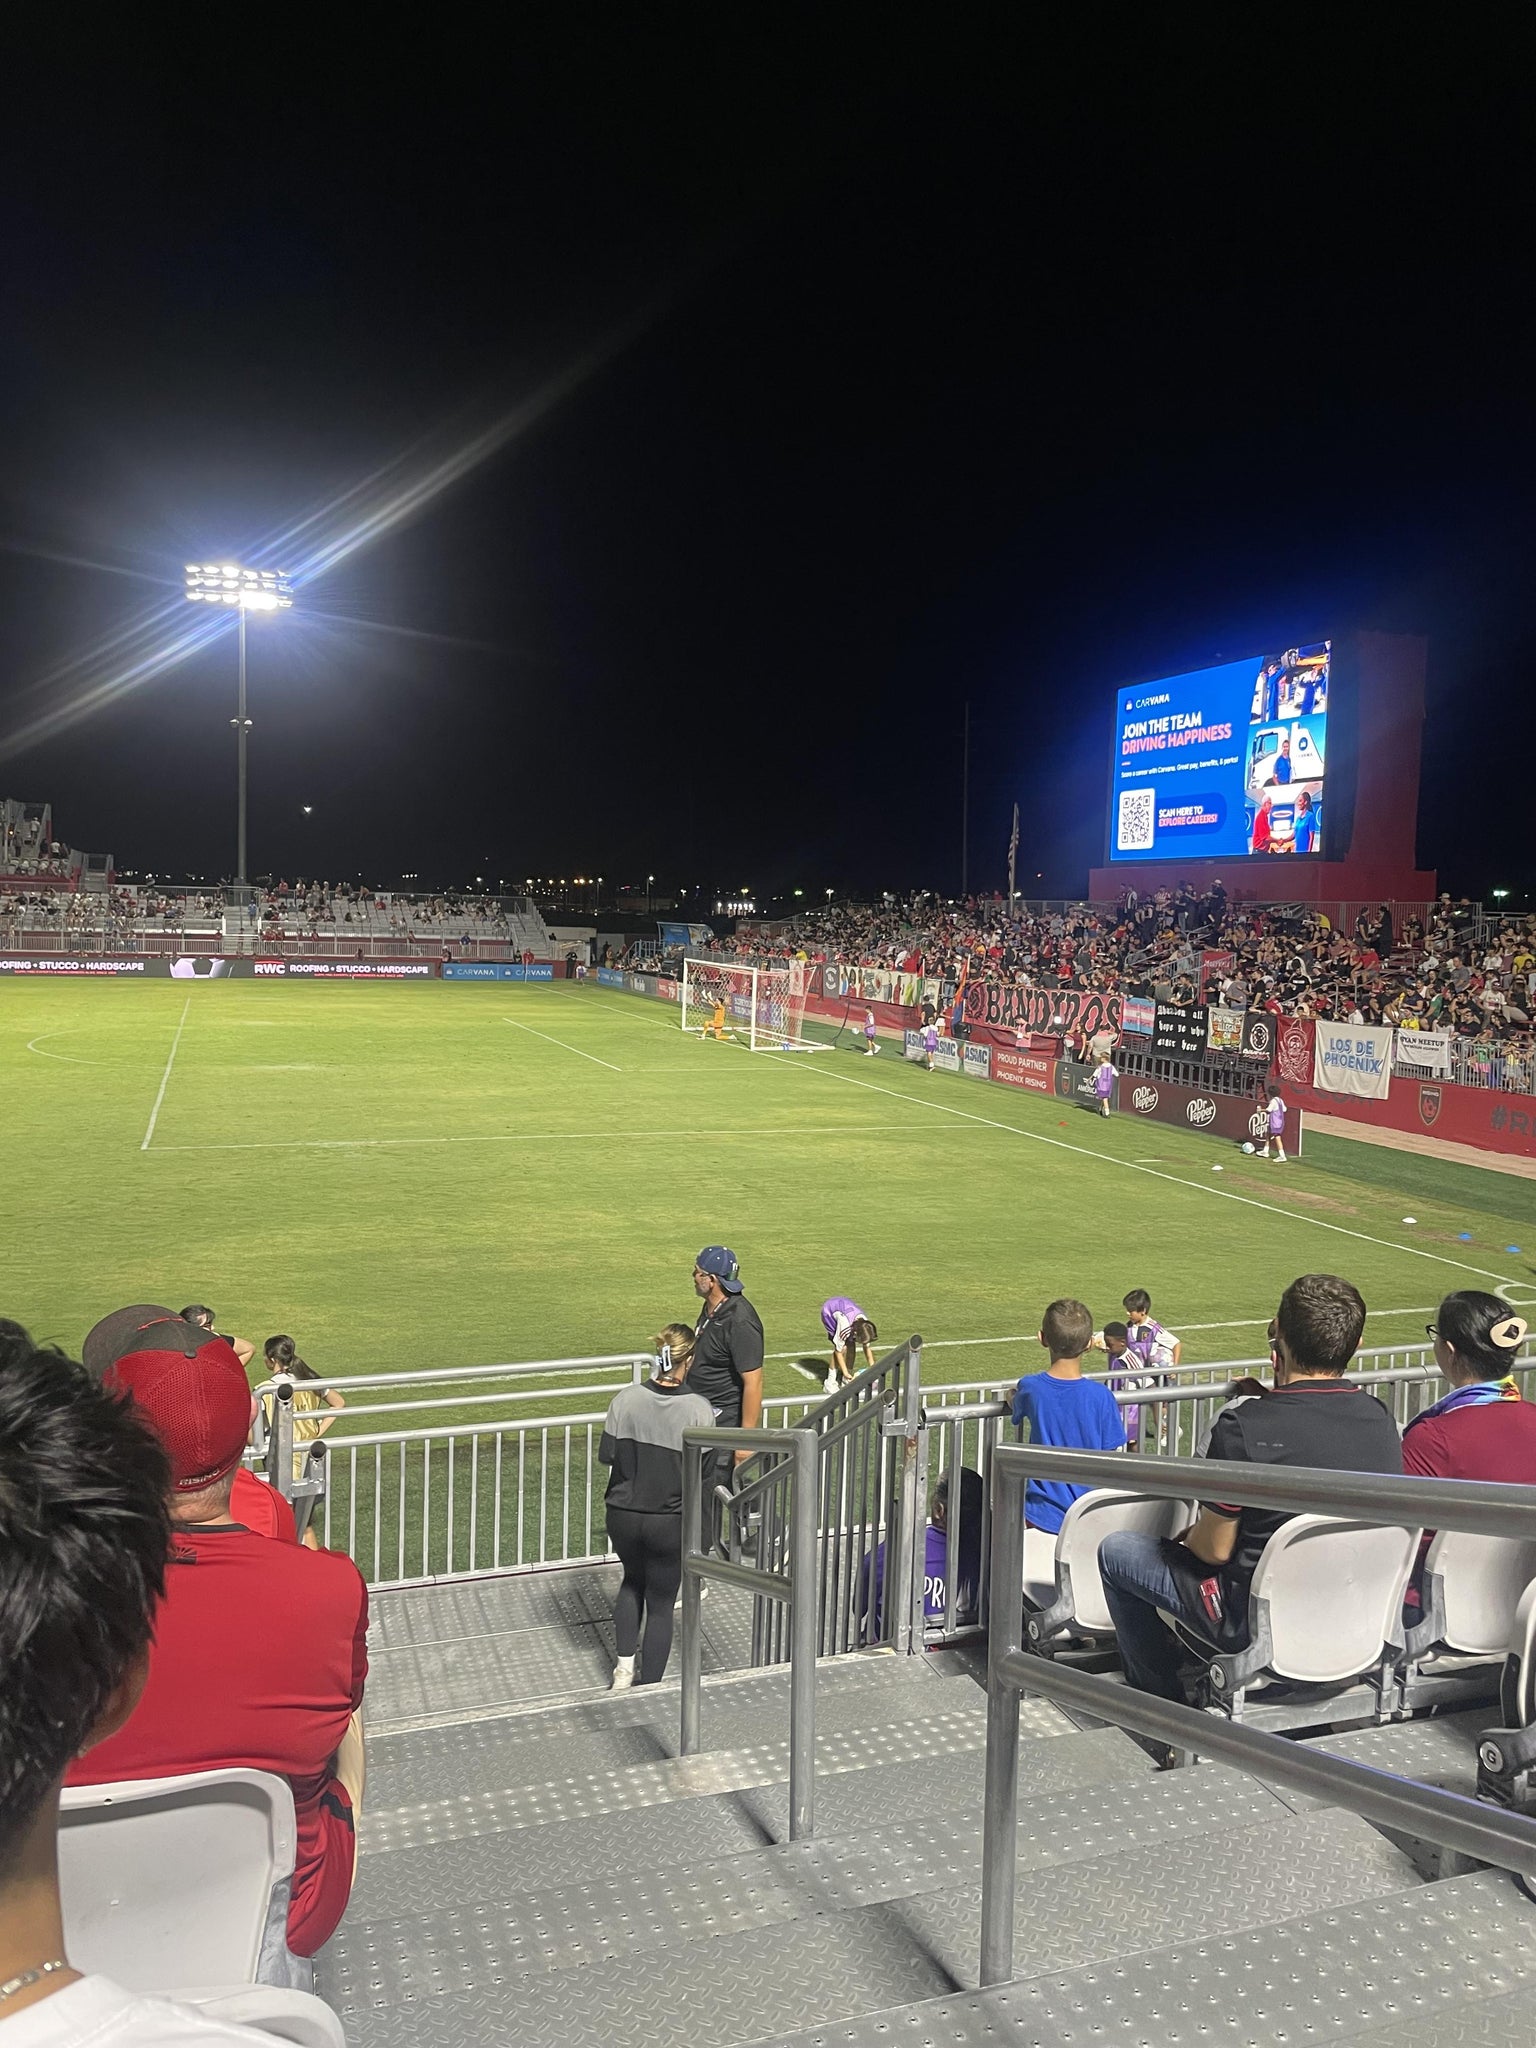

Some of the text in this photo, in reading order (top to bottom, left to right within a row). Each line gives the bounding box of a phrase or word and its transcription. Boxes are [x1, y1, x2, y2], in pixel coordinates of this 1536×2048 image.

[1136, 694, 1170, 708] CARVANA
[1122, 711, 1202, 740] JOIN THE TEAM
[1122, 723, 1232, 755] DRIVING HAPPINESS
[1159, 806, 1203, 818] SCAN HERE TO
[1159, 814, 1218, 827] EXPLORE CAREERS!
[39, 962, 79, 970] STUCCO
[86, 962, 144, 971] HARDSCAPE
[254, 964, 286, 974] RWC
[290, 964, 329, 973] ROOFING
[377, 966, 428, 974] HARDSCAPE
[1192, 1010, 1203, 1020] all
[1158, 1020, 1174, 1032] hope
[1190, 1026, 1205, 1037] who
[935, 1040, 956, 1056] ASMC
[1330, 1038, 1375, 1057] LOS DE
[1418, 1038, 1444, 1047] MEETUP
[965, 1046, 987, 1064] ASMC
[998, 1053, 1047, 1072] PROUD PARTNER
[1324, 1052, 1383, 1076] PHOENIX
[996, 1070, 1047, 1089] PHOENIX RISING
[1078, 1084, 1096, 1094] AMERIC
[1141, 1086, 1151, 1098] Dr
[1133, 1088, 1156, 1109] Pepper
[1197, 1098, 1208, 1111] Dr
[1188, 1100, 1213, 1123] Pepper
[924, 1576, 946, 1608] PR
[1031, 1625, 1036, 1635] E
[1215, 1670, 1221, 1680] F
[1487, 1750, 1496, 1765] G
